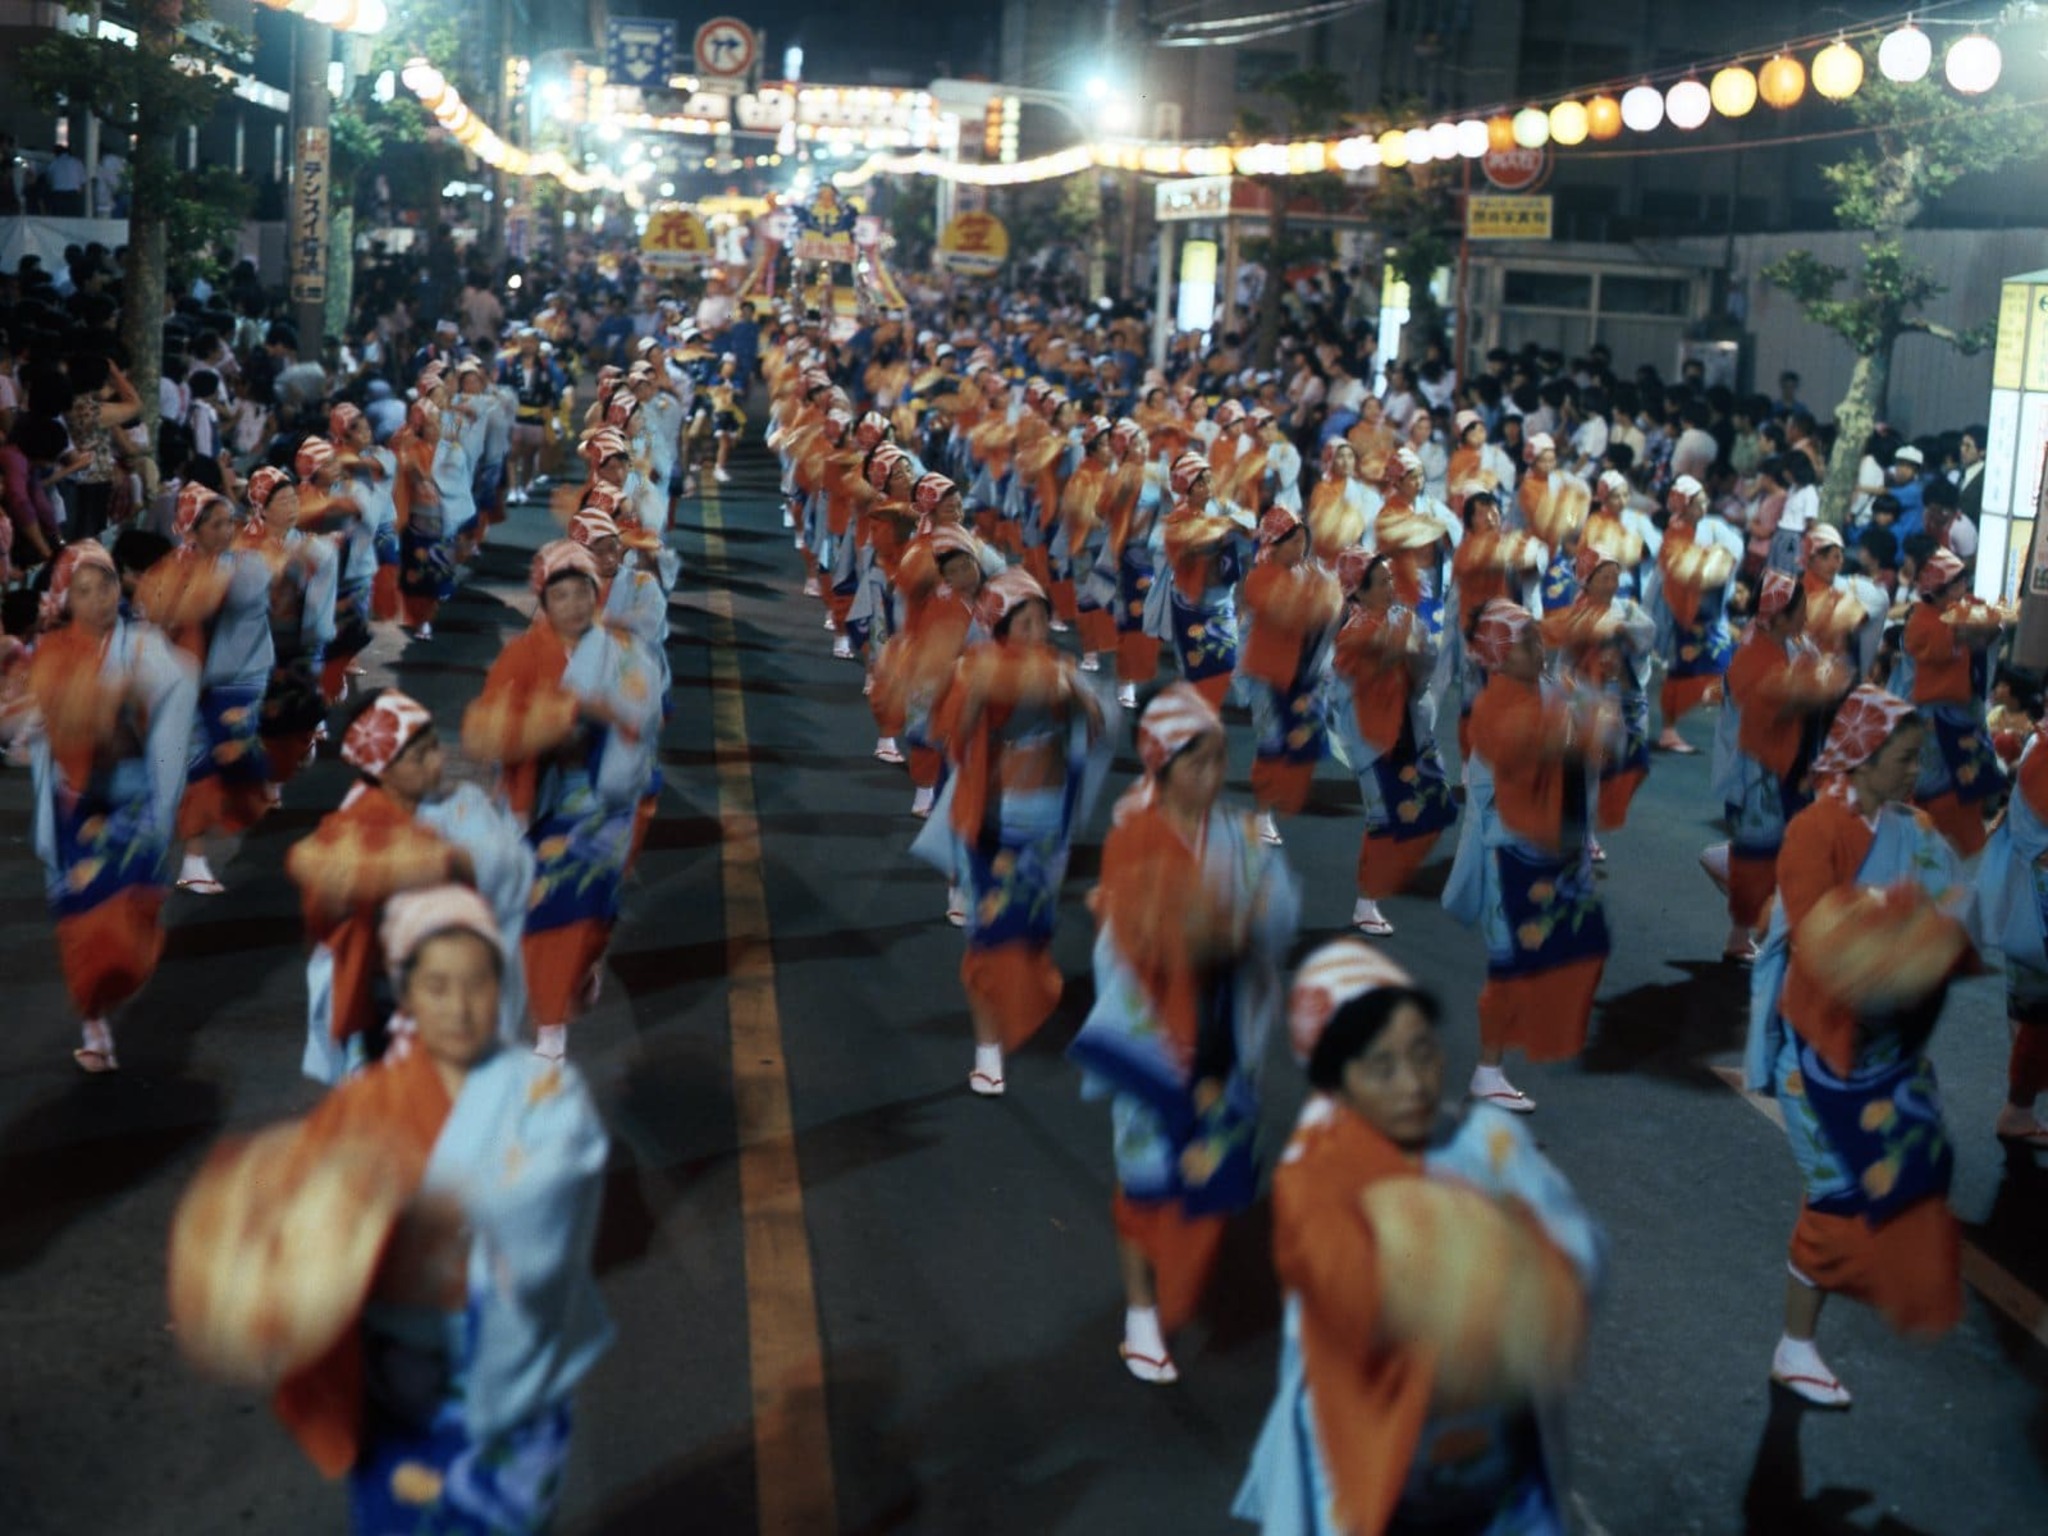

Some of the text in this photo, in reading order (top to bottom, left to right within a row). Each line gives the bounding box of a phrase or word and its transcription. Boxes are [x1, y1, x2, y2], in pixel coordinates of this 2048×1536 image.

[301, 162, 321, 275] テンスイ
[653, 211, 697, 249] 花
[956, 213, 994, 251] 笠
